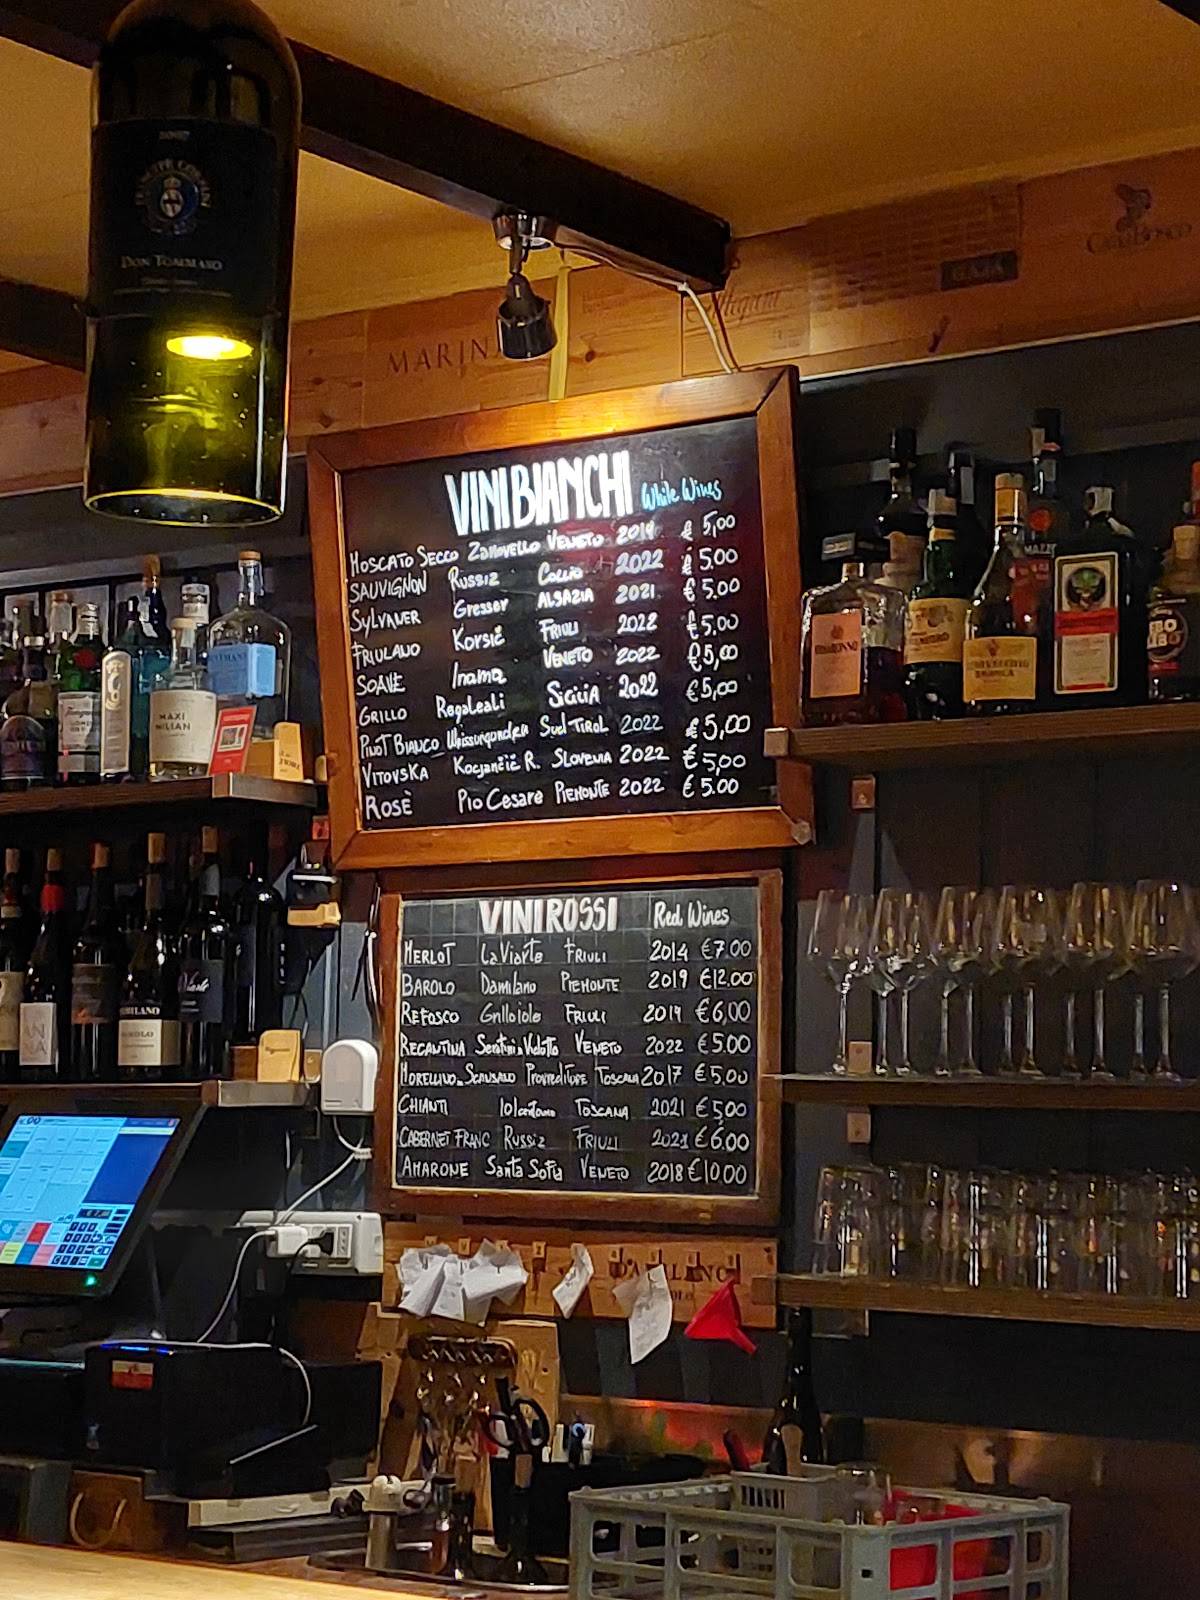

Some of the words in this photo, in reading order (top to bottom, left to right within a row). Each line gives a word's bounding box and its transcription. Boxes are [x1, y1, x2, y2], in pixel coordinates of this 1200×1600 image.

[641, 480, 680, 511] White
[682, 476, 722, 501] Wines
[417, 545, 459, 567] SECCO
[350, 571, 427, 602] SAUVIGNON
[614, 549, 664, 575] 2022
[615, 583, 655, 604] 2021
[356, 671, 406, 696] SOAVE
[543, 645, 593, 669] VENETO
[615, 646, 660, 665] 2022
[359, 706, 407, 726] GRILLO
[618, 671, 658, 698] 2022
[620, 714, 663, 734] 2022
[362, 762, 429, 789] VITOVSKA
[524, 750, 541, 772] R.
[619, 744, 669, 764] 2022
[486, 787, 544, 812] Cesare
[619, 777, 664, 797] 2022
[654, 901, 683, 929] Red
[688, 900, 730, 928] Wines
[404, 939, 456, 965] MERLOT
[564, 938, 606, 963] FRIULI
[650, 940, 688, 962] 2014
[401, 973, 455, 997] BAROLO
[480, 971, 537, 995] Damilano
[648, 969, 688, 989] 2019
[564, 1003, 606, 1024] FRIULI
[574, 1029, 622, 1056] VENETO
[645, 1036, 684, 1056] 2022
[641, 1064, 682, 1086] 2017
[397, 1094, 448, 1116] CHIANTI
[650, 1096, 684, 1117] 2021
[453, 1128, 491, 1149] FRANC
[401, 1155, 469, 1178] AMARONE
[485, 1155, 524, 1178] Santa
[580, 1153, 629, 1182] VENETO
[647, 1161, 684, 1183] 2018
